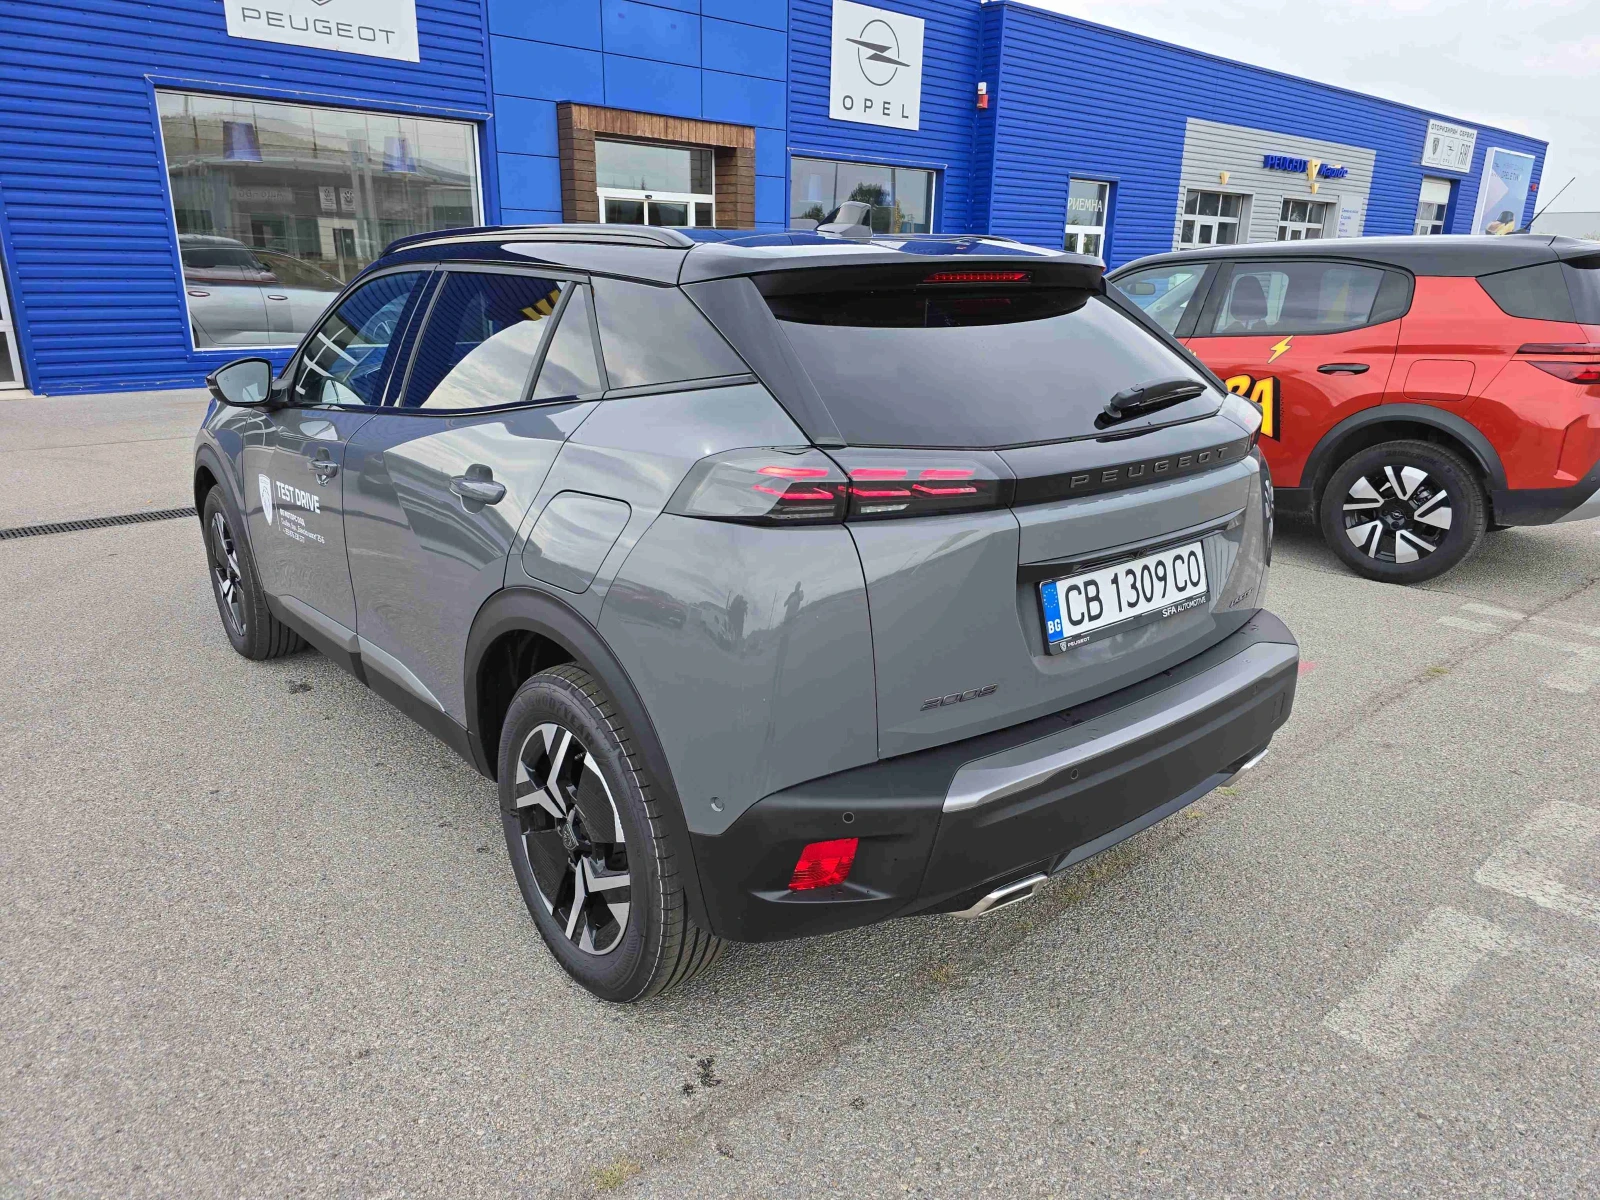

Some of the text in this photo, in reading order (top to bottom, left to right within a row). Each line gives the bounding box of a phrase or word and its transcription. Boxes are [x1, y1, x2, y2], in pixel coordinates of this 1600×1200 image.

[241, 7, 395, 44] PEUGEOT
[842, 95, 909, 119] OPEL
[1069, 447, 1228, 489] PEUGEOT
[275, 480, 321, 514] TEST DRIVE
[1065, 550, 1201, 626] CB 1309 CO
[1162, 596, 1206, 618] SFA AUTOMOTIVE
[1047, 619, 1062, 634] BG
[1067, 636, 1090, 647] PEUGEOT
[920, 683, 998, 711] 2008
